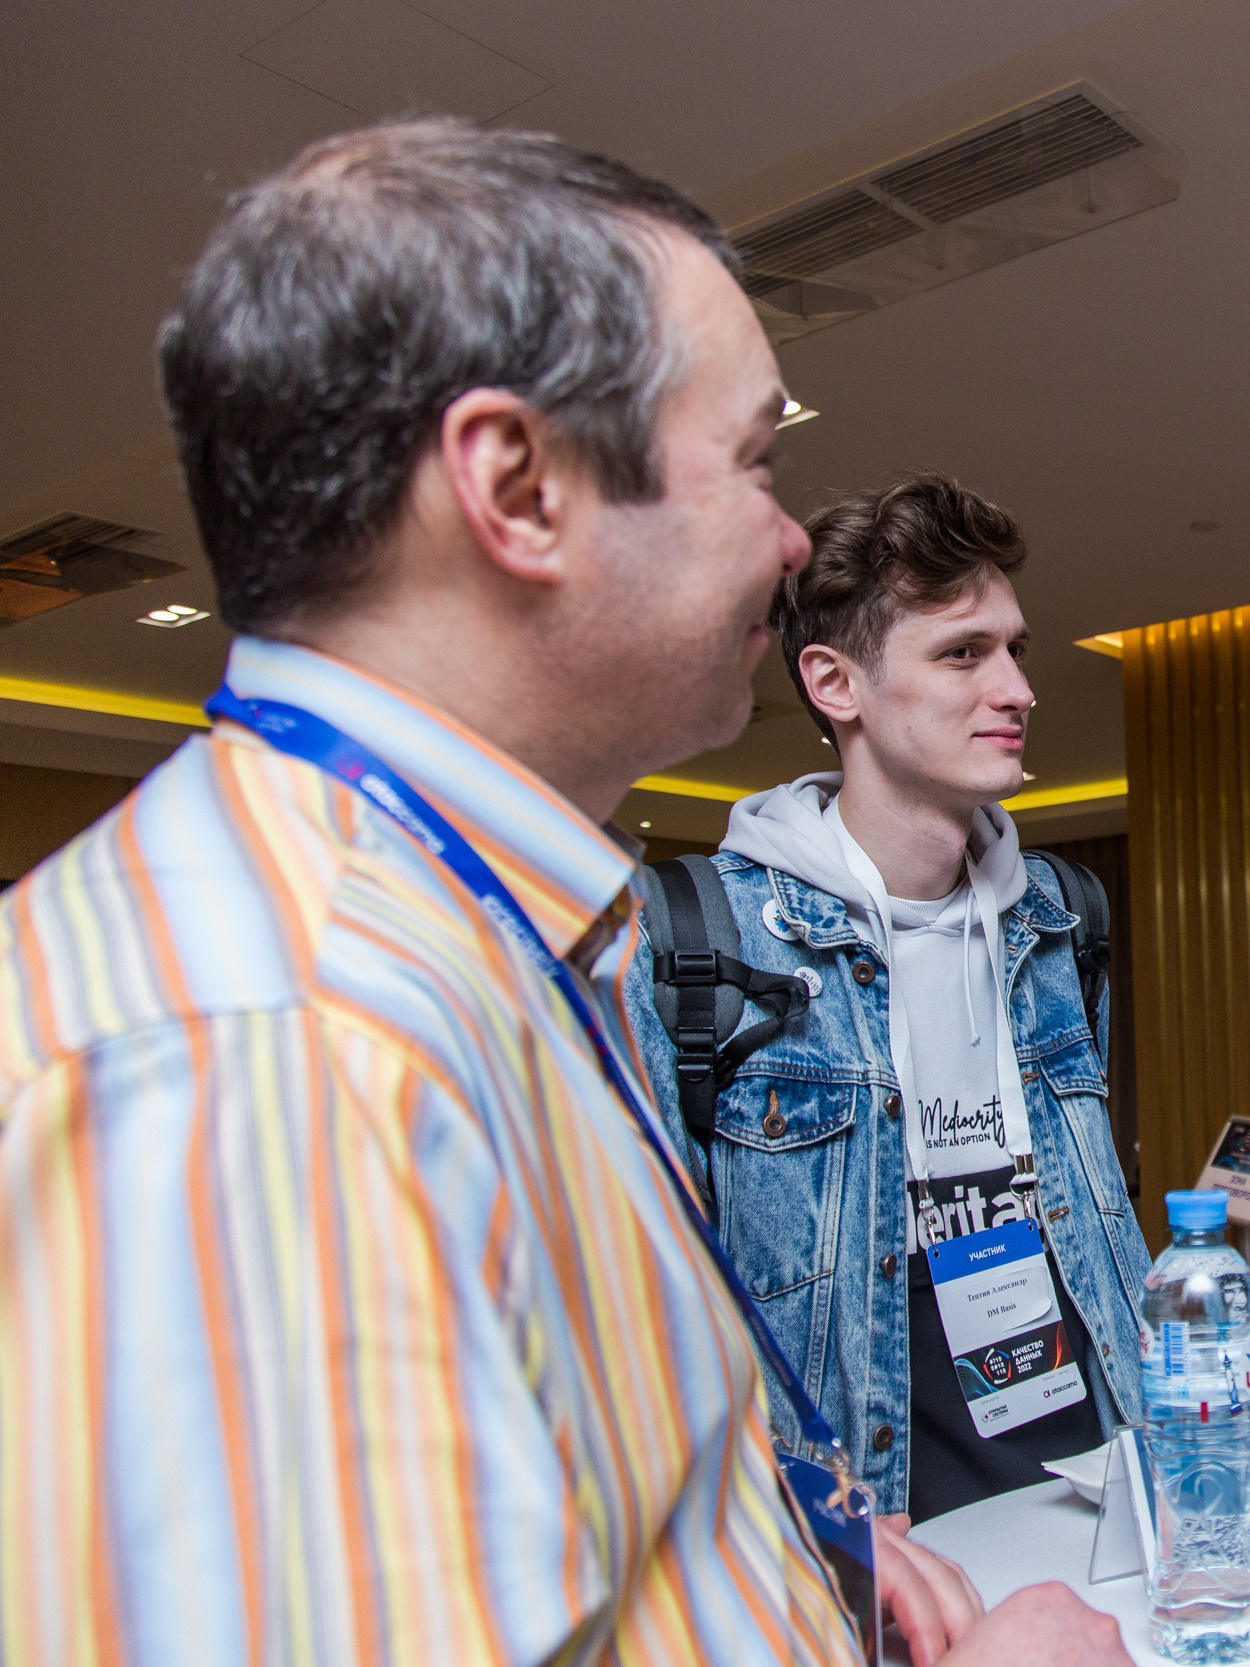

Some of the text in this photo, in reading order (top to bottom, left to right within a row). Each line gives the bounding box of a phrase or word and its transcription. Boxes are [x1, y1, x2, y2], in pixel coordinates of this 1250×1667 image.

[918, 1094, 1006, 1149] Mediocrity
[926, 1132, 991, 1149] IS NOT AN OPTION
[968, 1243, 1007, 1262] УЧАСТНИК
[987, 1302, 1017, 1318] DM Basis
[1011, 1339, 1044, 1358] КАЧЕСТВО
[1015, 1349, 1043, 1366] ДАННЫХ
[1017, 1362, 1033, 1374] 2022
[1051, 1380, 1078, 1395] ataccama
